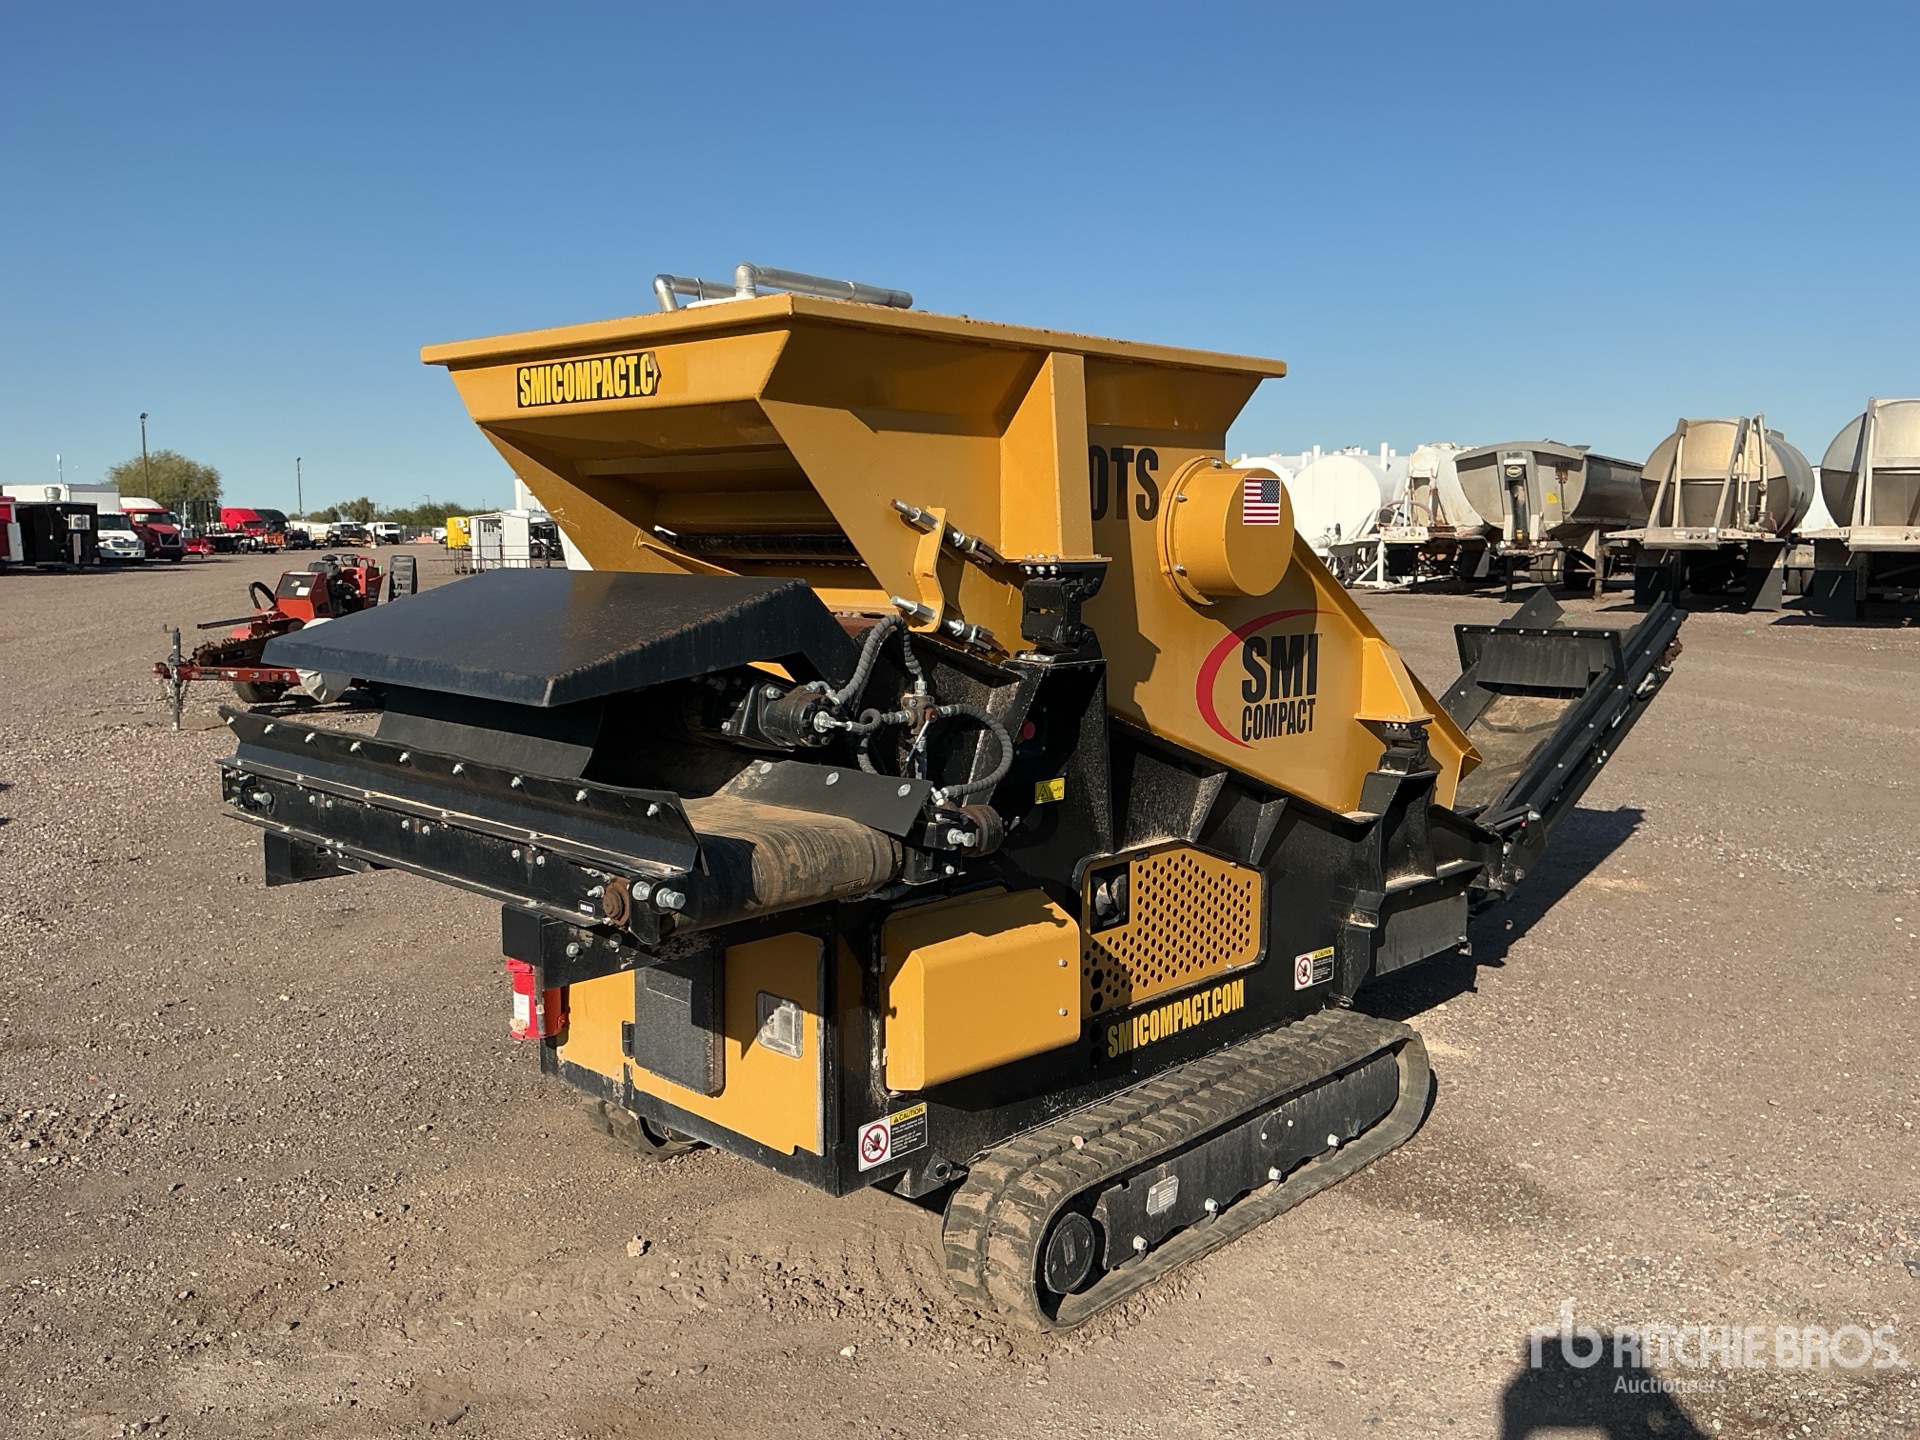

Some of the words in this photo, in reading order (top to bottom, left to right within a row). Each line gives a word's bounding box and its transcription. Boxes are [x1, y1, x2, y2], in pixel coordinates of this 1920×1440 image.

[519, 353, 659, 406] SMICOMPACT.C
[1242, 633, 1319, 704] SMI
[1242, 697, 1316, 742] COMPACT
[1107, 978, 1245, 1059] SMICOMPACT.COM
[899, 1107, 923, 1121] CAUTION
